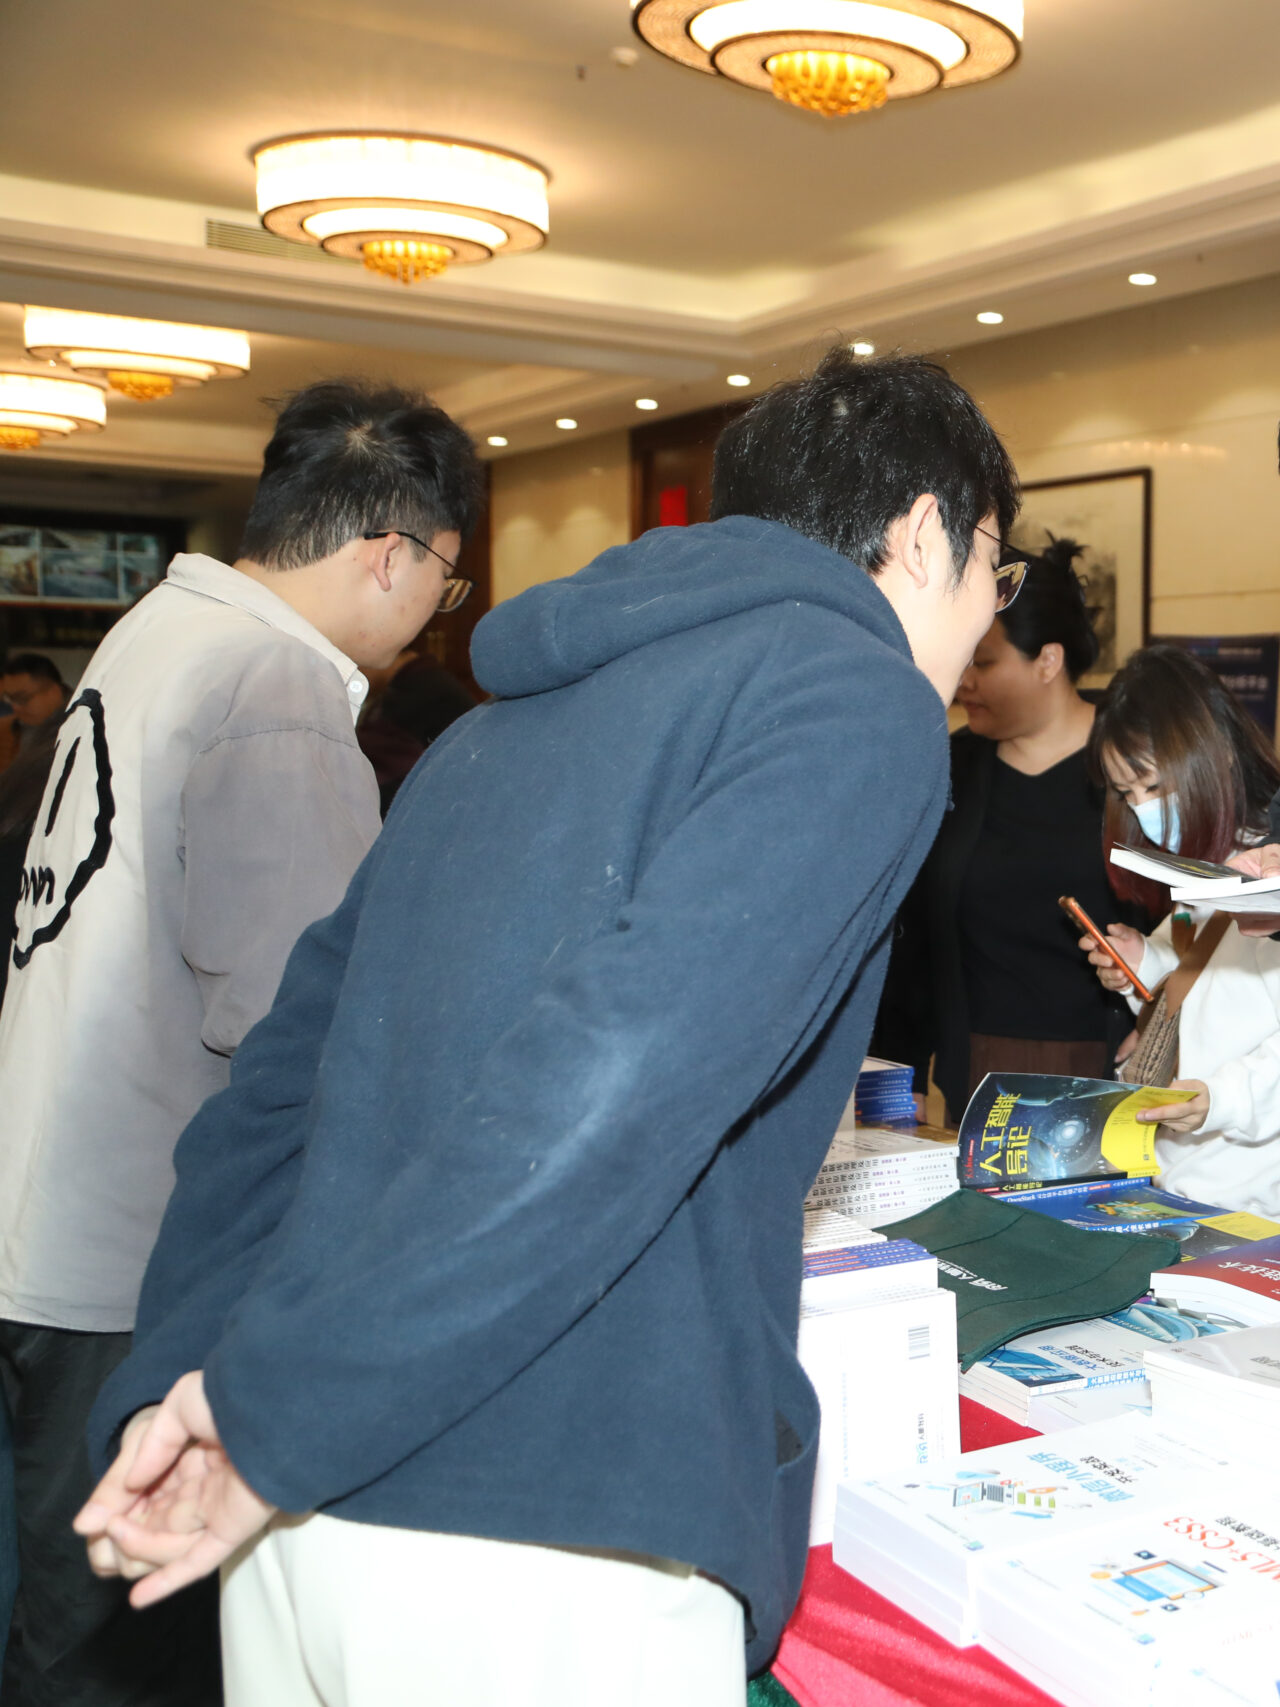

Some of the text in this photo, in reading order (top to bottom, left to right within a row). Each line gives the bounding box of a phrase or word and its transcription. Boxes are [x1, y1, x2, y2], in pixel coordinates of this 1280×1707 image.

[979, 1093, 1021, 1177] 人工智能
[1006, 1125, 1032, 1176] 导论
[1026, 1452, 1135, 1503] 微信小程序
[1079, 1455, 1134, 1486] 开发实战
